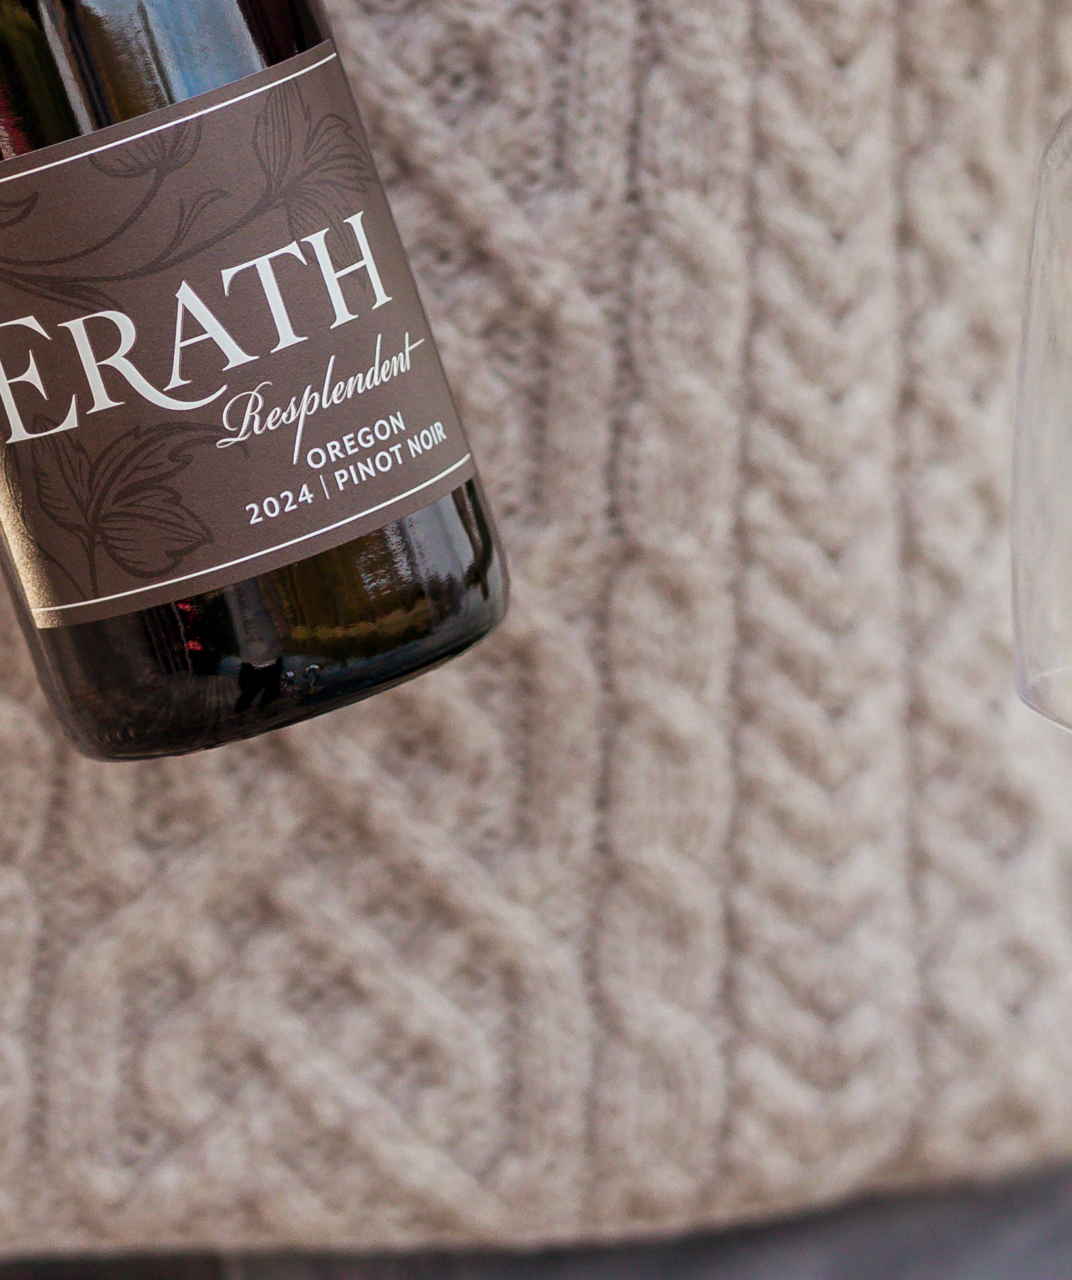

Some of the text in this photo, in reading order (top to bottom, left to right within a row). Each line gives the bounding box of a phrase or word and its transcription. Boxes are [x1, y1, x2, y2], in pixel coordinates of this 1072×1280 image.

[215, 331, 426, 465] Resplendent
[306, 410, 407, 470] OREGON
[245, 420, 448, 525] 2024 PINOT NOIR
